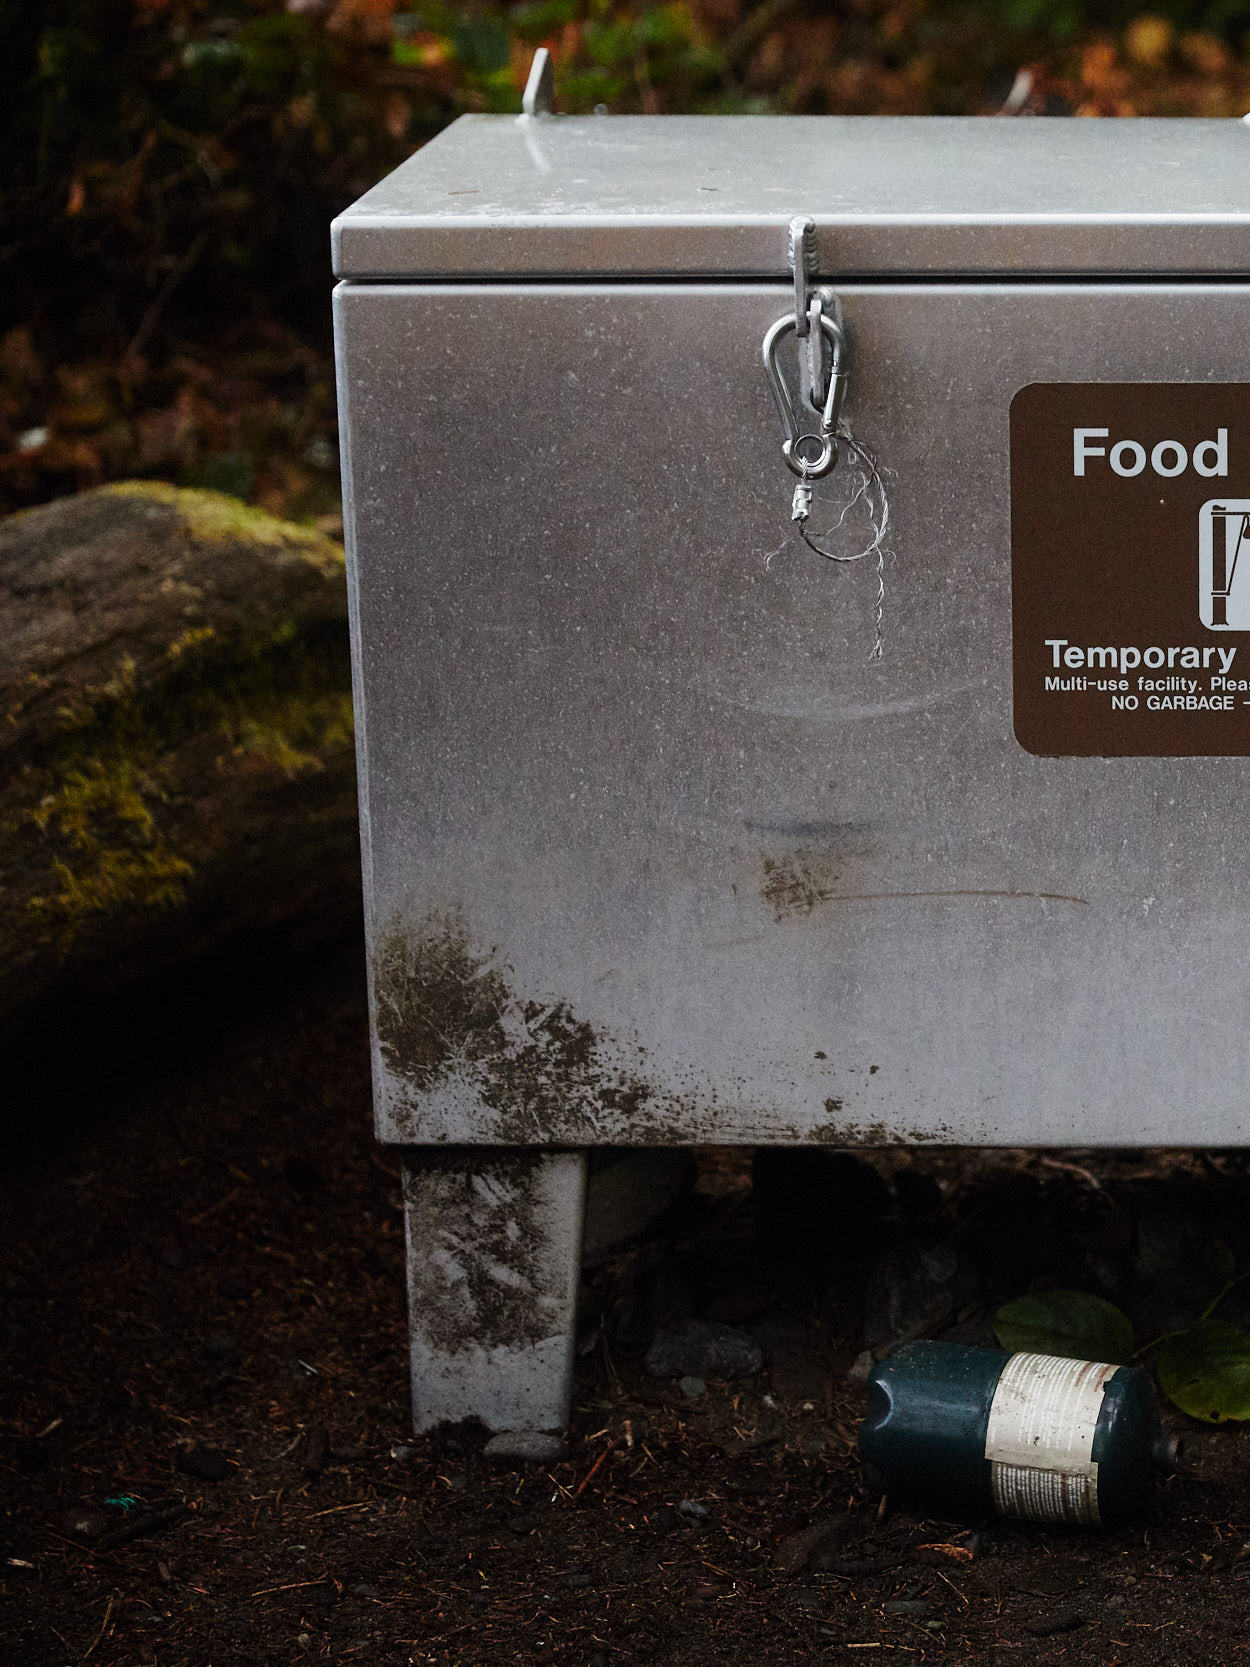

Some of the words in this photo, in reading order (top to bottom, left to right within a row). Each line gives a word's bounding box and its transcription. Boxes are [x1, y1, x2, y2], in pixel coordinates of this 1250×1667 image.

[1074, 427, 1228, 478] Food
[1045, 640, 1237, 675] Temporary
[1044, 676, 1129, 691] Multi-use
[1137, 676, 1203, 694] facility.
[1111, 696, 1139, 711] NO
[1146, 695, 1235, 711] GARBAGE
